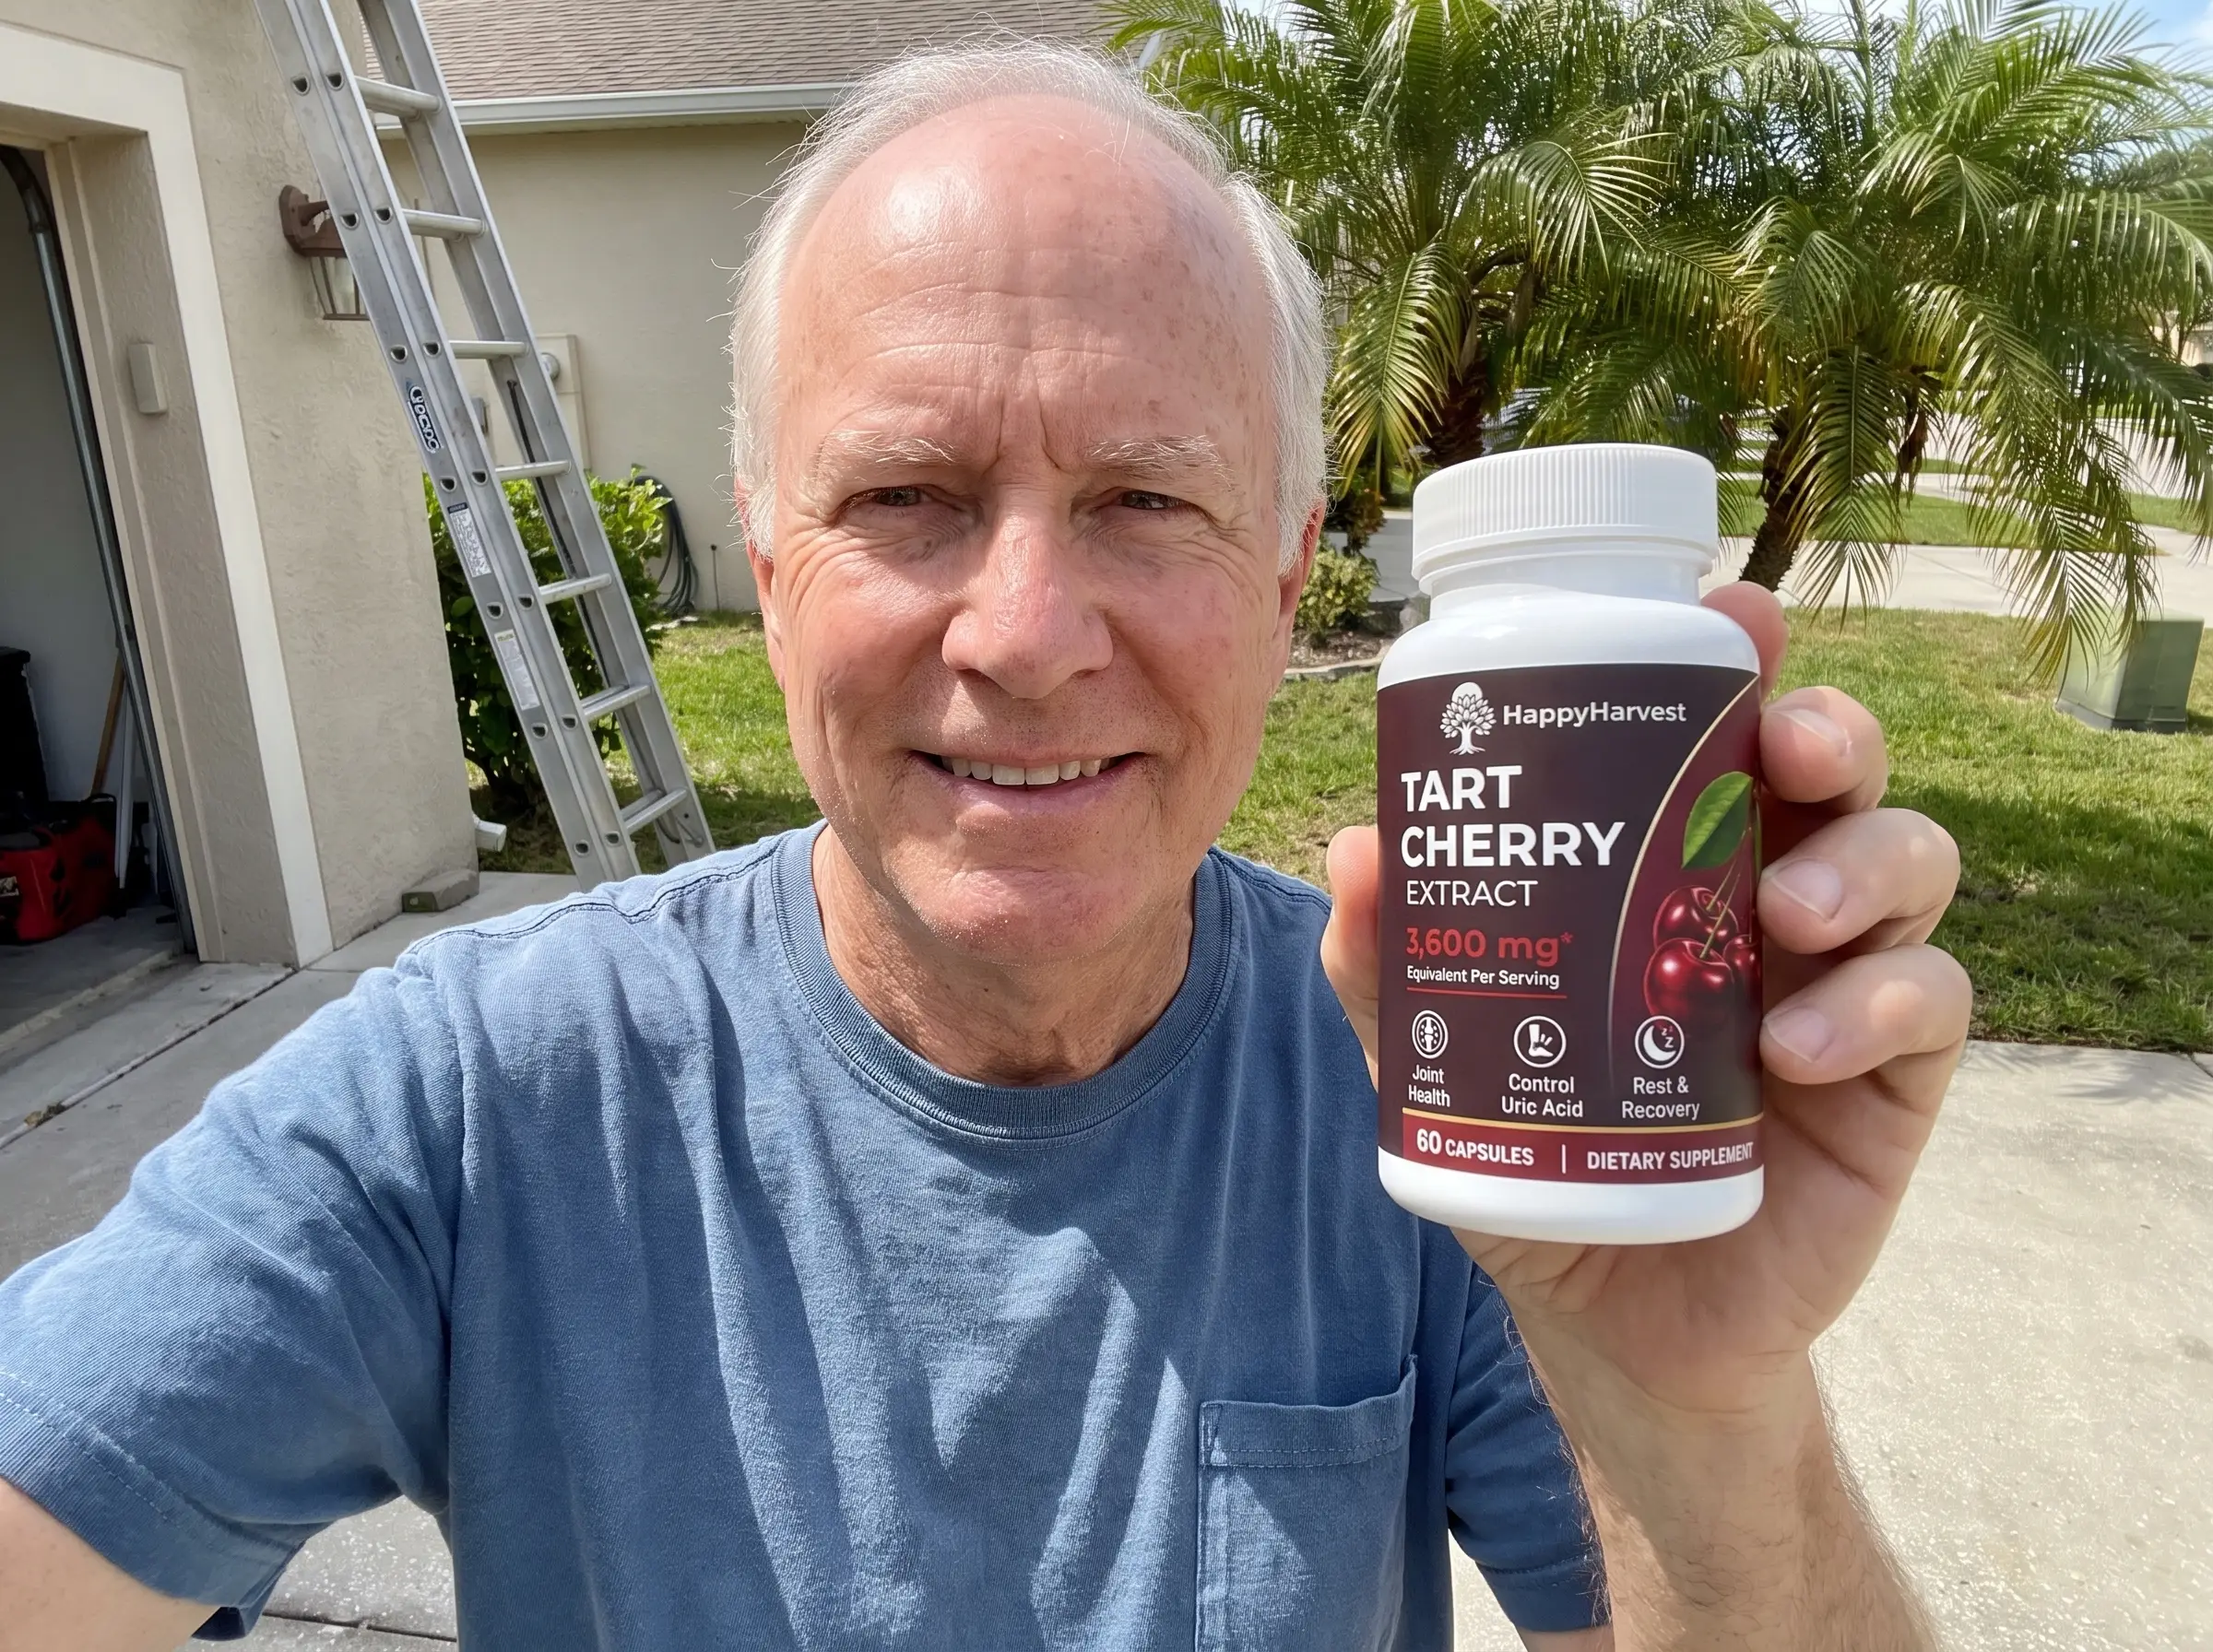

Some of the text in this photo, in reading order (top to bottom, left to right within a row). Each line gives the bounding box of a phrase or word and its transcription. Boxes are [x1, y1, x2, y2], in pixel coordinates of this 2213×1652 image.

[1504, 702, 1686, 728] HappyHarvest
[1402, 765, 1521, 811] TART
[1402, 822, 1625, 867] CHERRY
[1407, 880, 1538, 906] EXTRACT
[1407, 927, 1485, 959] 3,600
[1408, 965, 1559, 989] Equivalent Per Serving
[1412, 1065, 1445, 1084] Joint
[1509, 1074, 1574, 1093] Control
[1634, 1076, 1688, 1094] Rest &
[1408, 1084, 1450, 1108] Health
[1502, 1096, 1582, 1117] Uric Acid
[1623, 1101, 1699, 1120] Recovery
[1417, 1128, 1534, 1166] 60 CAPSULES
[1588, 1142, 1754, 1170] DIETARY SUPPLEMENT
